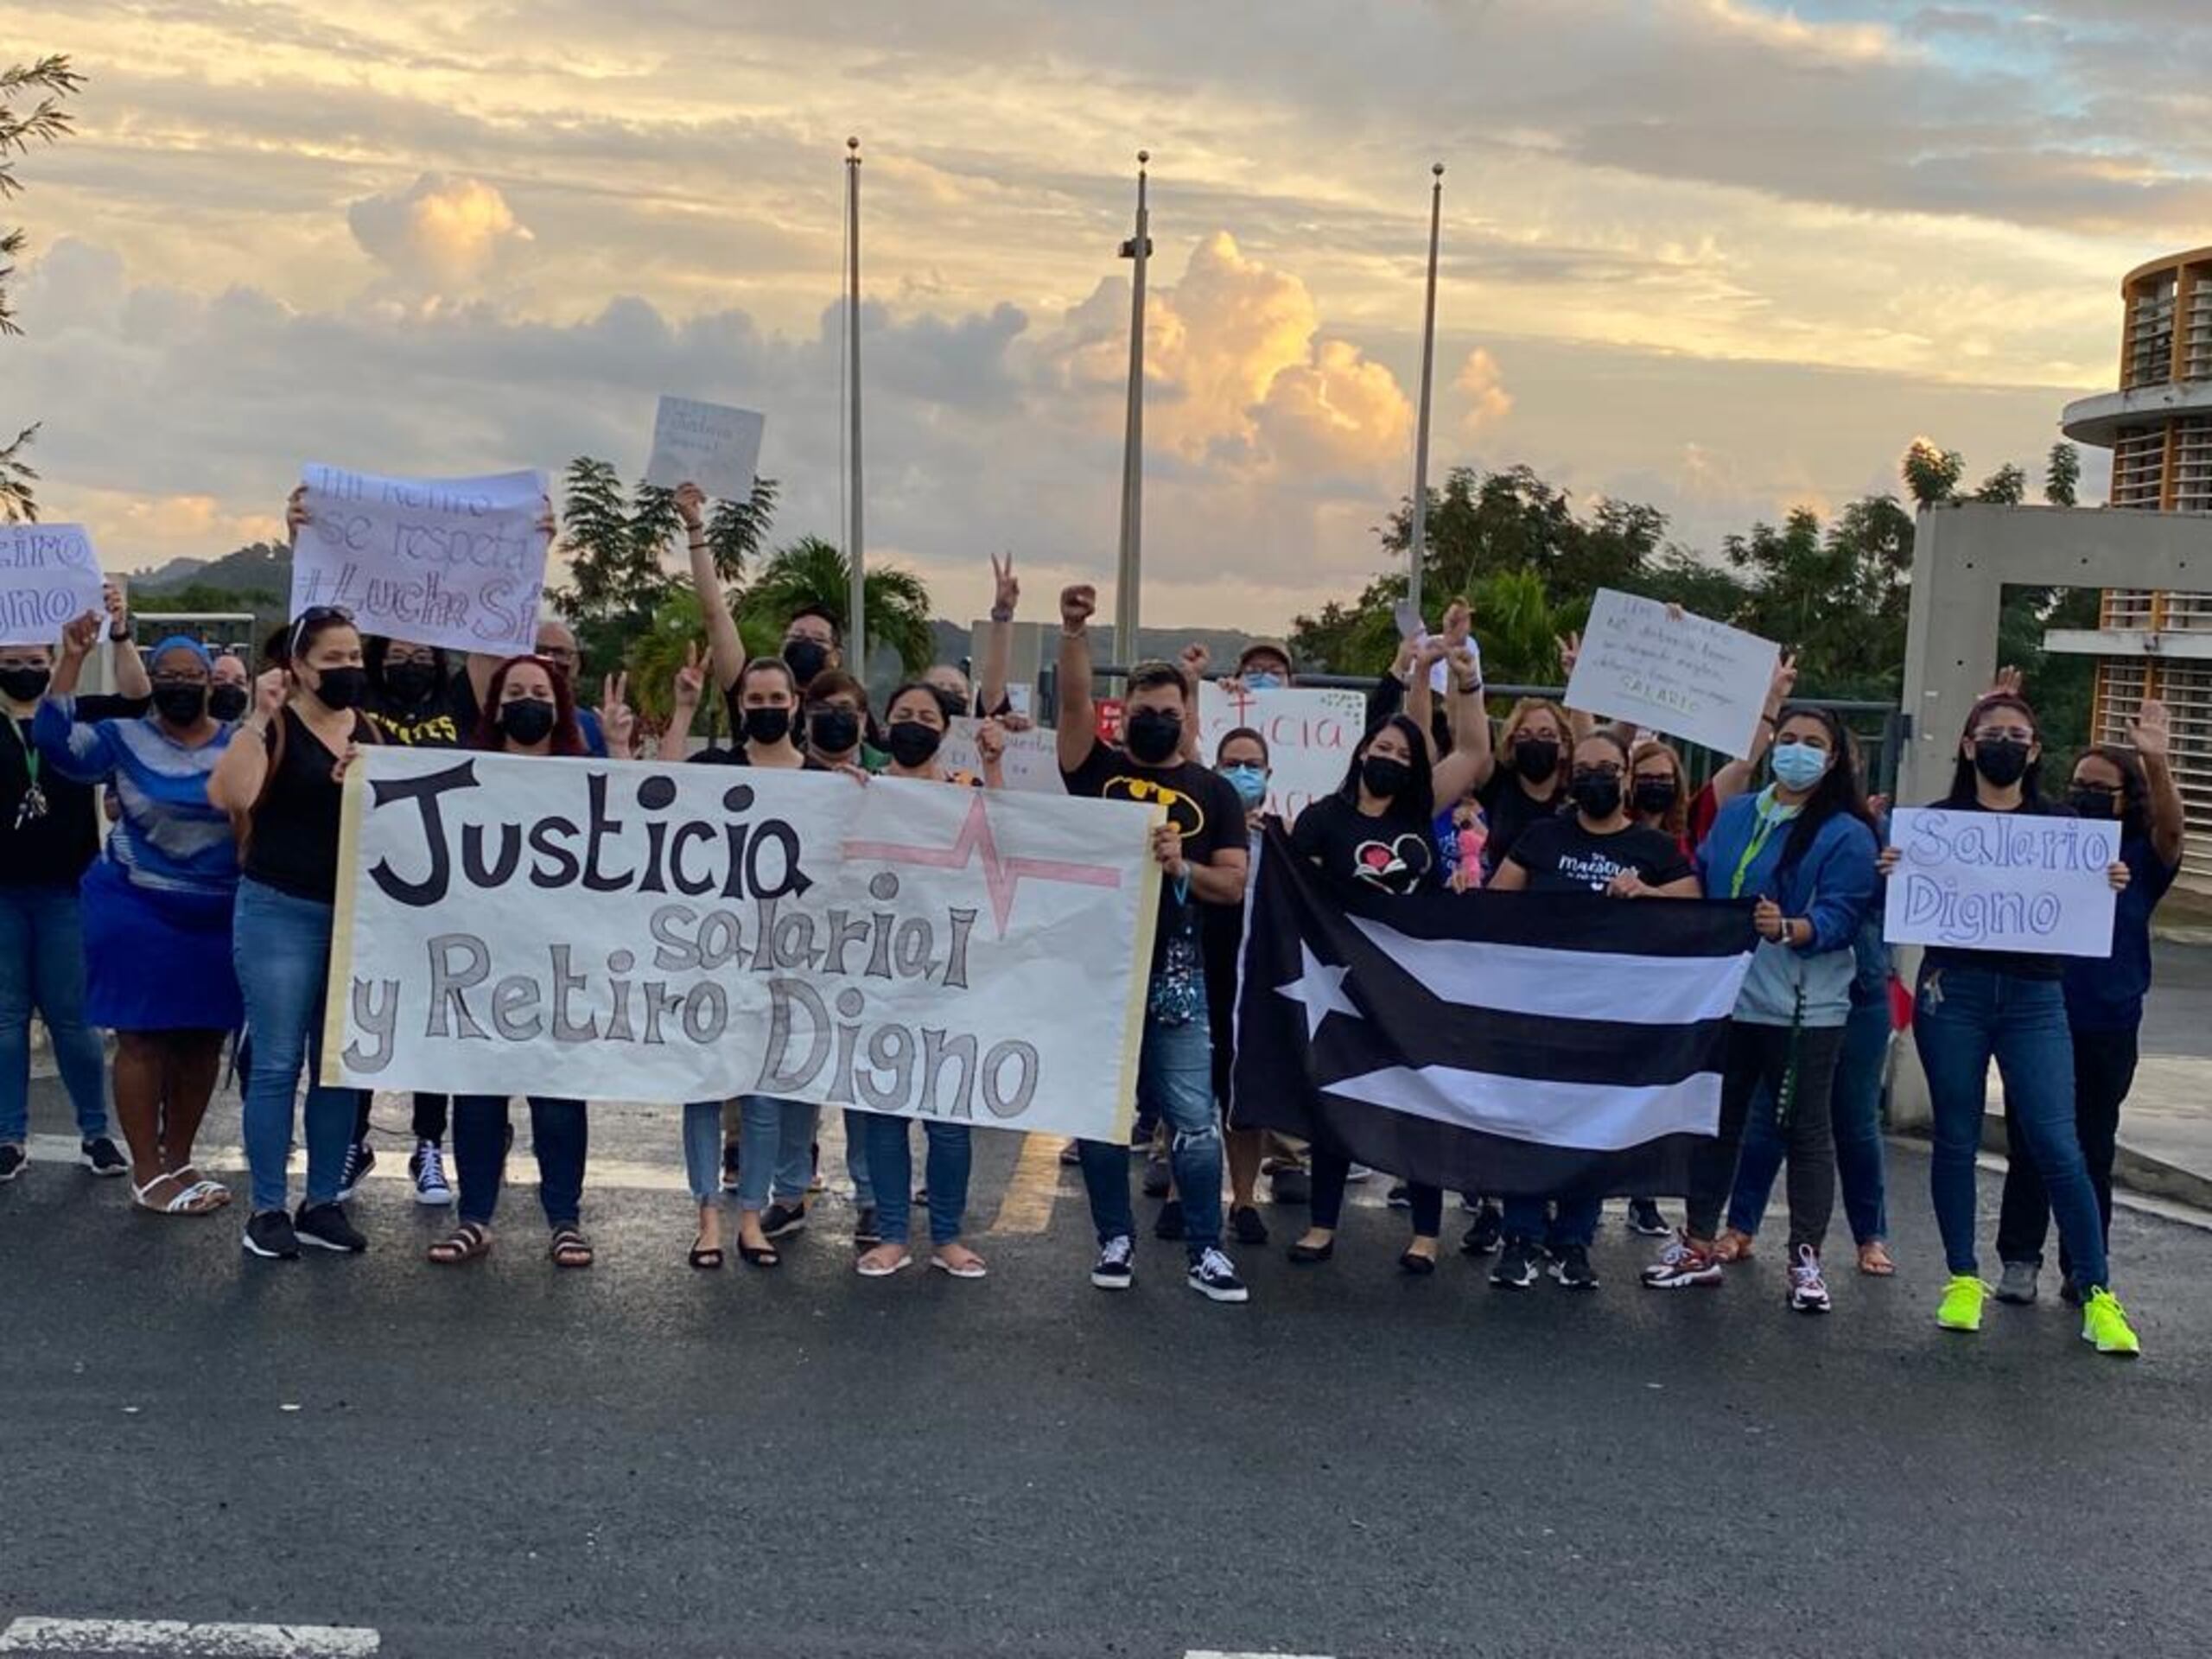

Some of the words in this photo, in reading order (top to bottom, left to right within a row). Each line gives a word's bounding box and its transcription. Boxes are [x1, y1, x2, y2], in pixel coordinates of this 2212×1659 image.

[369, 757, 814, 908] Justicia
[1907, 810, 2110, 873] Salario
[650, 871, 978, 989] salarial
[1904, 873, 2063, 946] Digno
[341, 978, 400, 1074] y
[426, 932, 729, 1045] Retiro
[753, 977, 1039, 1120] Digno
